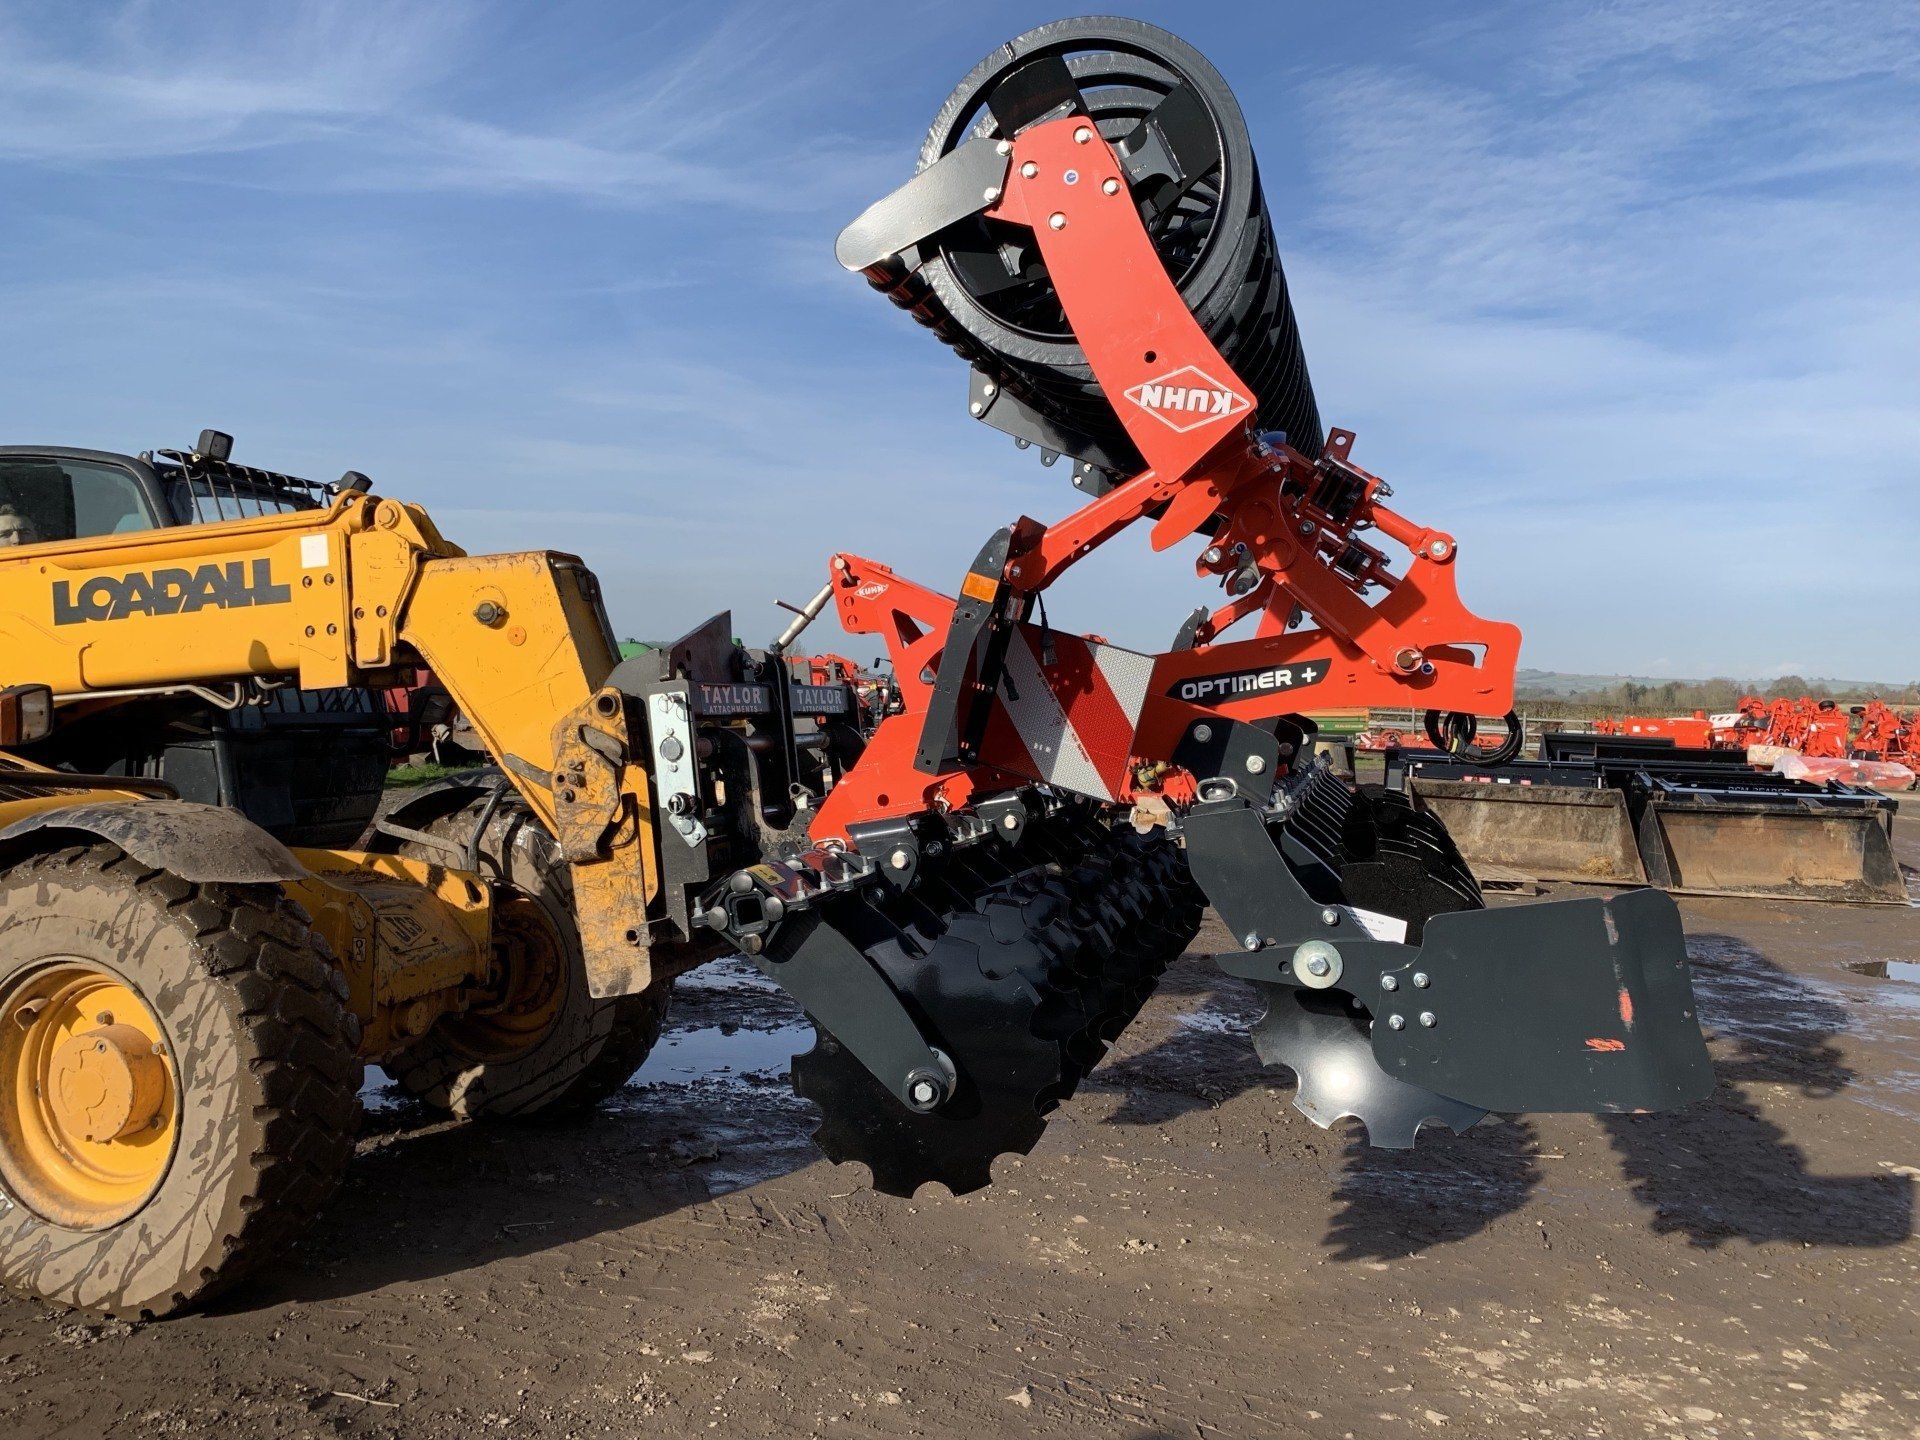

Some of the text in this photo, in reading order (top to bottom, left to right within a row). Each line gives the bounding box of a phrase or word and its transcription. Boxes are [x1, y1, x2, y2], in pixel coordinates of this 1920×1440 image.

[1139, 384, 1233, 415] KUHN
[52, 557, 292, 626] LOADALL
[701, 684, 762, 704] TAYLOR
[796, 688, 842, 705] TAYLOR
[1181, 669, 1293, 700] OPTIMER
